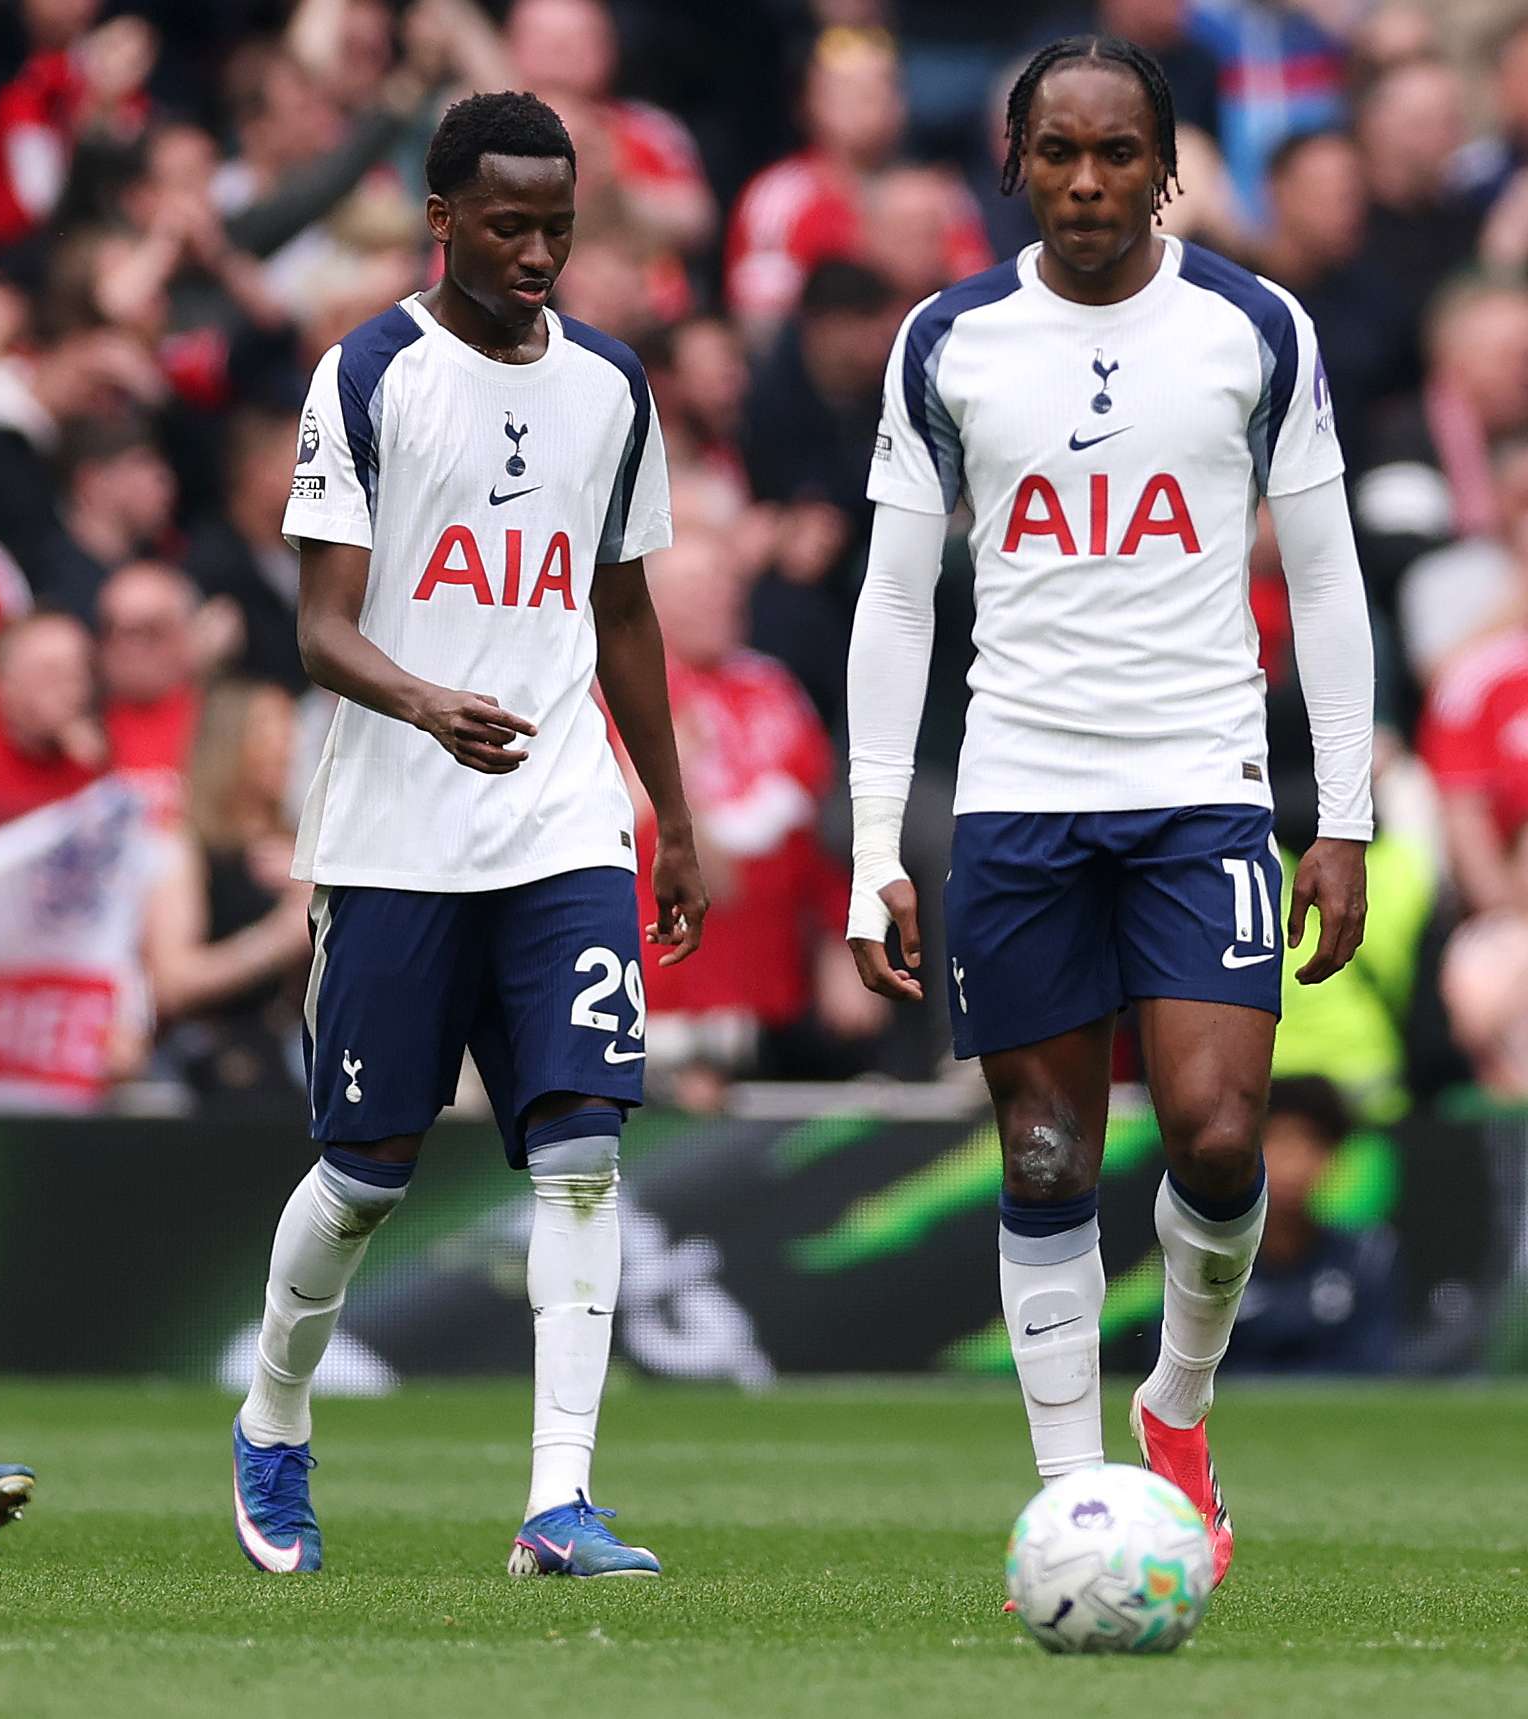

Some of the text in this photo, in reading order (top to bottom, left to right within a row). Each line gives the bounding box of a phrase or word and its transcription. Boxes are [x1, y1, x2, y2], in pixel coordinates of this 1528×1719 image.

[291, 488, 325, 499] acism
[292, 477, 320, 489] oom
[1001, 472, 1202, 556] AIA
[412, 524, 577, 610] AIA
[1221, 858, 1274, 949] 11
[570, 946, 645, 1040] 29
